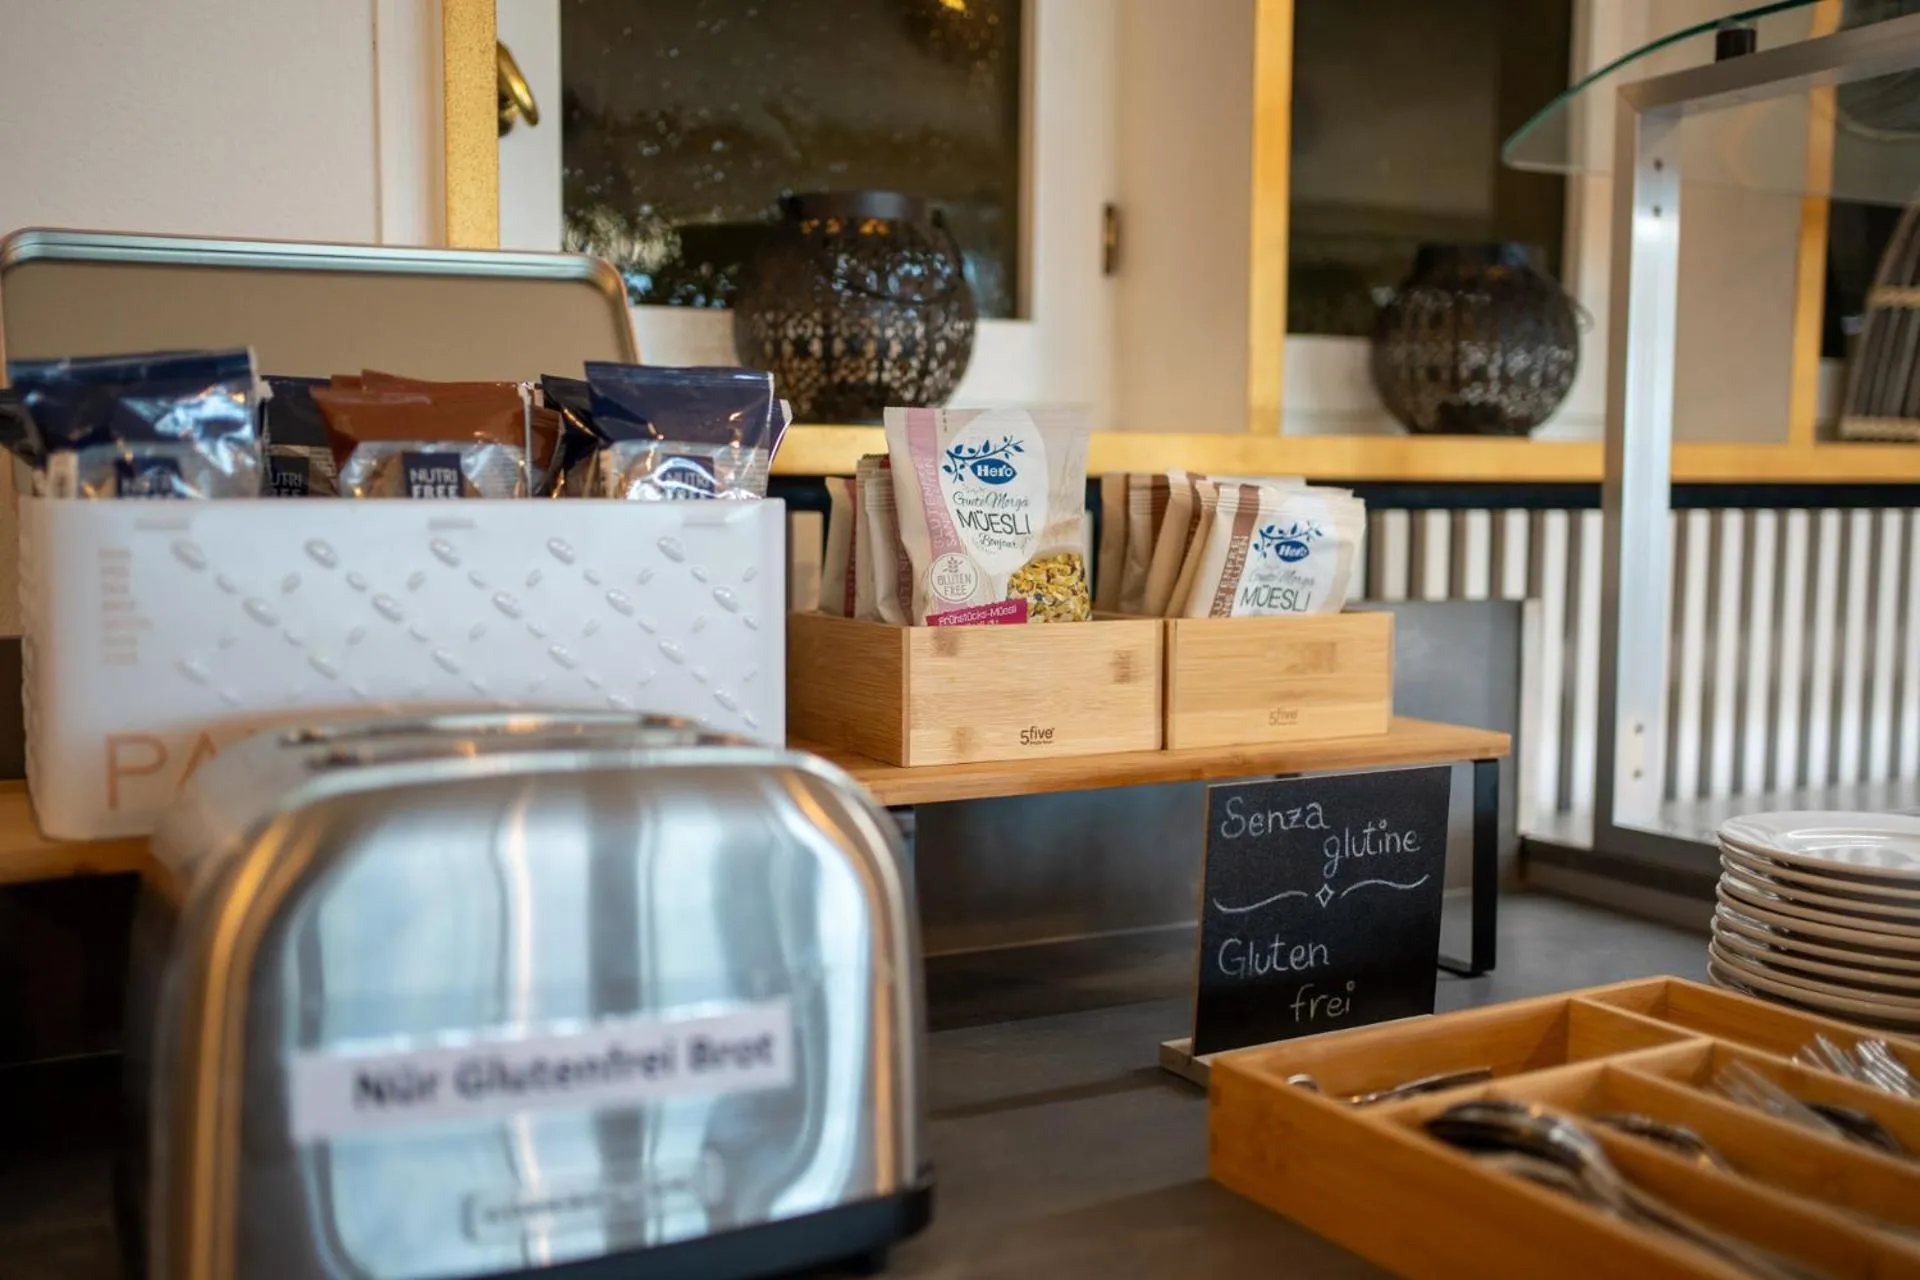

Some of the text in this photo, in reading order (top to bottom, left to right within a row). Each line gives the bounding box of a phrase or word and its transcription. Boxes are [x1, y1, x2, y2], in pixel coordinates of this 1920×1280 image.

[271, 472, 303, 486] UTRI
[409, 468, 457, 484] NUTRI
[976, 464, 1013, 478] Hero
[411, 484, 459, 500] FREE
[956, 508, 1031, 535] MÜESLI
[1279, 544, 1308, 557] Hero
[937, 573, 971, 586] GLUTEN
[944, 585, 968, 596] FREE
[1240, 584, 1311, 612] MÜESLI
[107, 732, 219, 810] PA
[1221, 796, 1331, 839] Senza
[1323, 819, 1421, 879] glutine
[1217, 933, 1330, 980] Gluten
[1289, 980, 1355, 1022] frei
[453, 1034, 678, 1102] Glutenfrei
[688, 1030, 774, 1075] Brot
